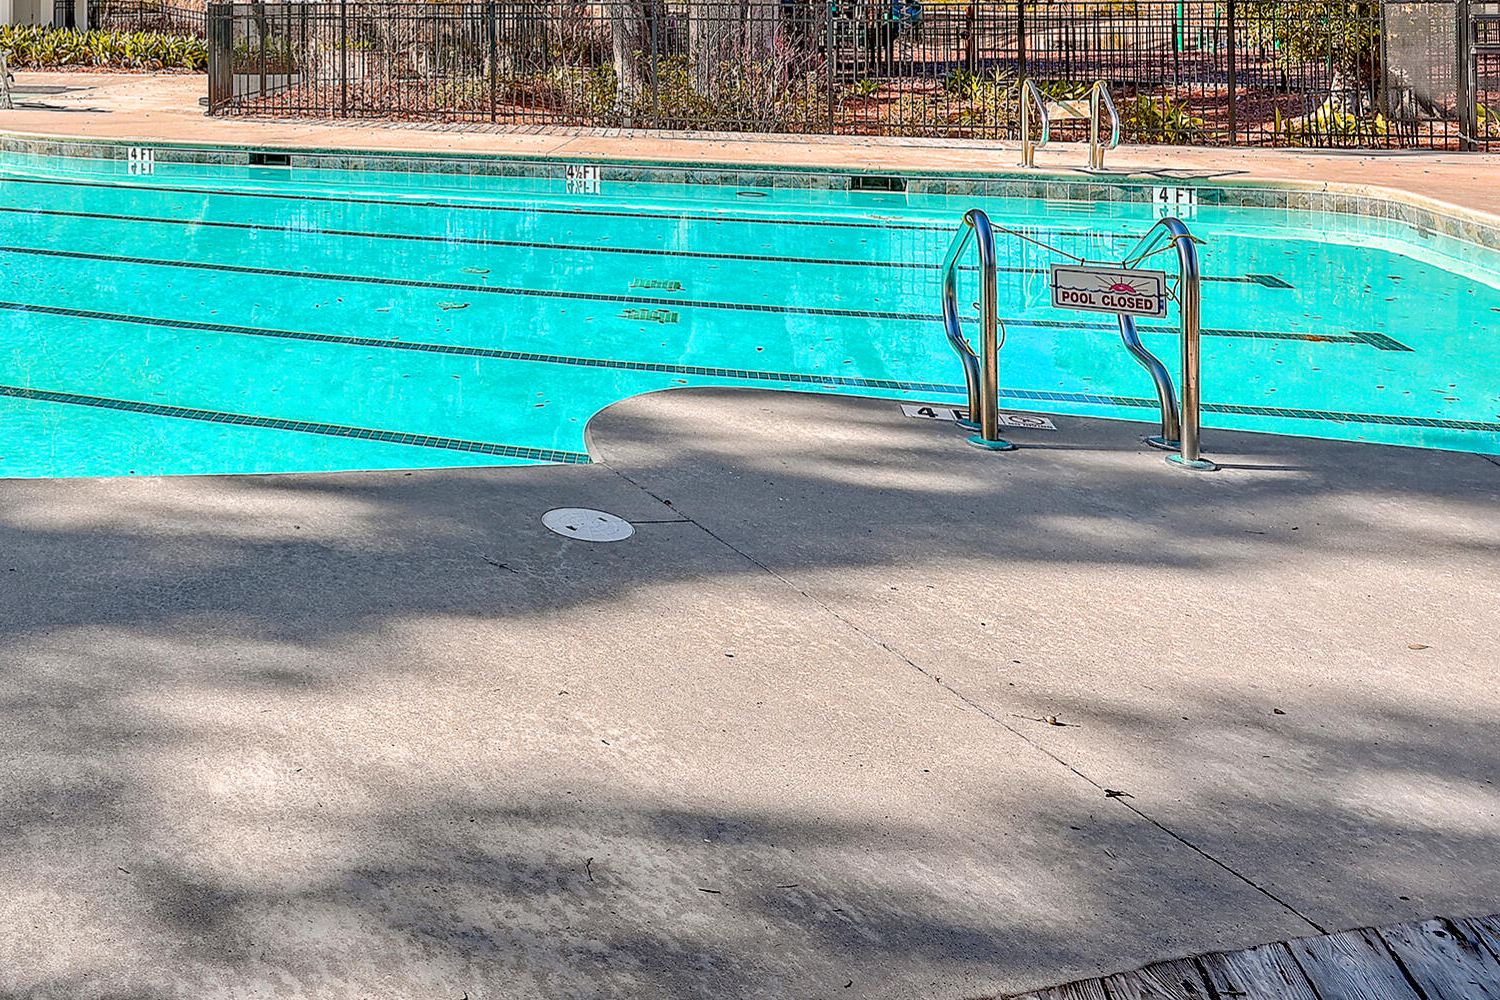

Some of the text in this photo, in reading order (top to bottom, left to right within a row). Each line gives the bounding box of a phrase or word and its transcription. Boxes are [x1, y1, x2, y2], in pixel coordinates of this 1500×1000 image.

[131, 147, 153, 161] 4 FT
[1159, 186, 1196, 204] 4 FT
[1062, 291, 1096, 305] POOL
[1101, 295, 1153, 310] CLOSED
[917, 407, 939, 418] 4
